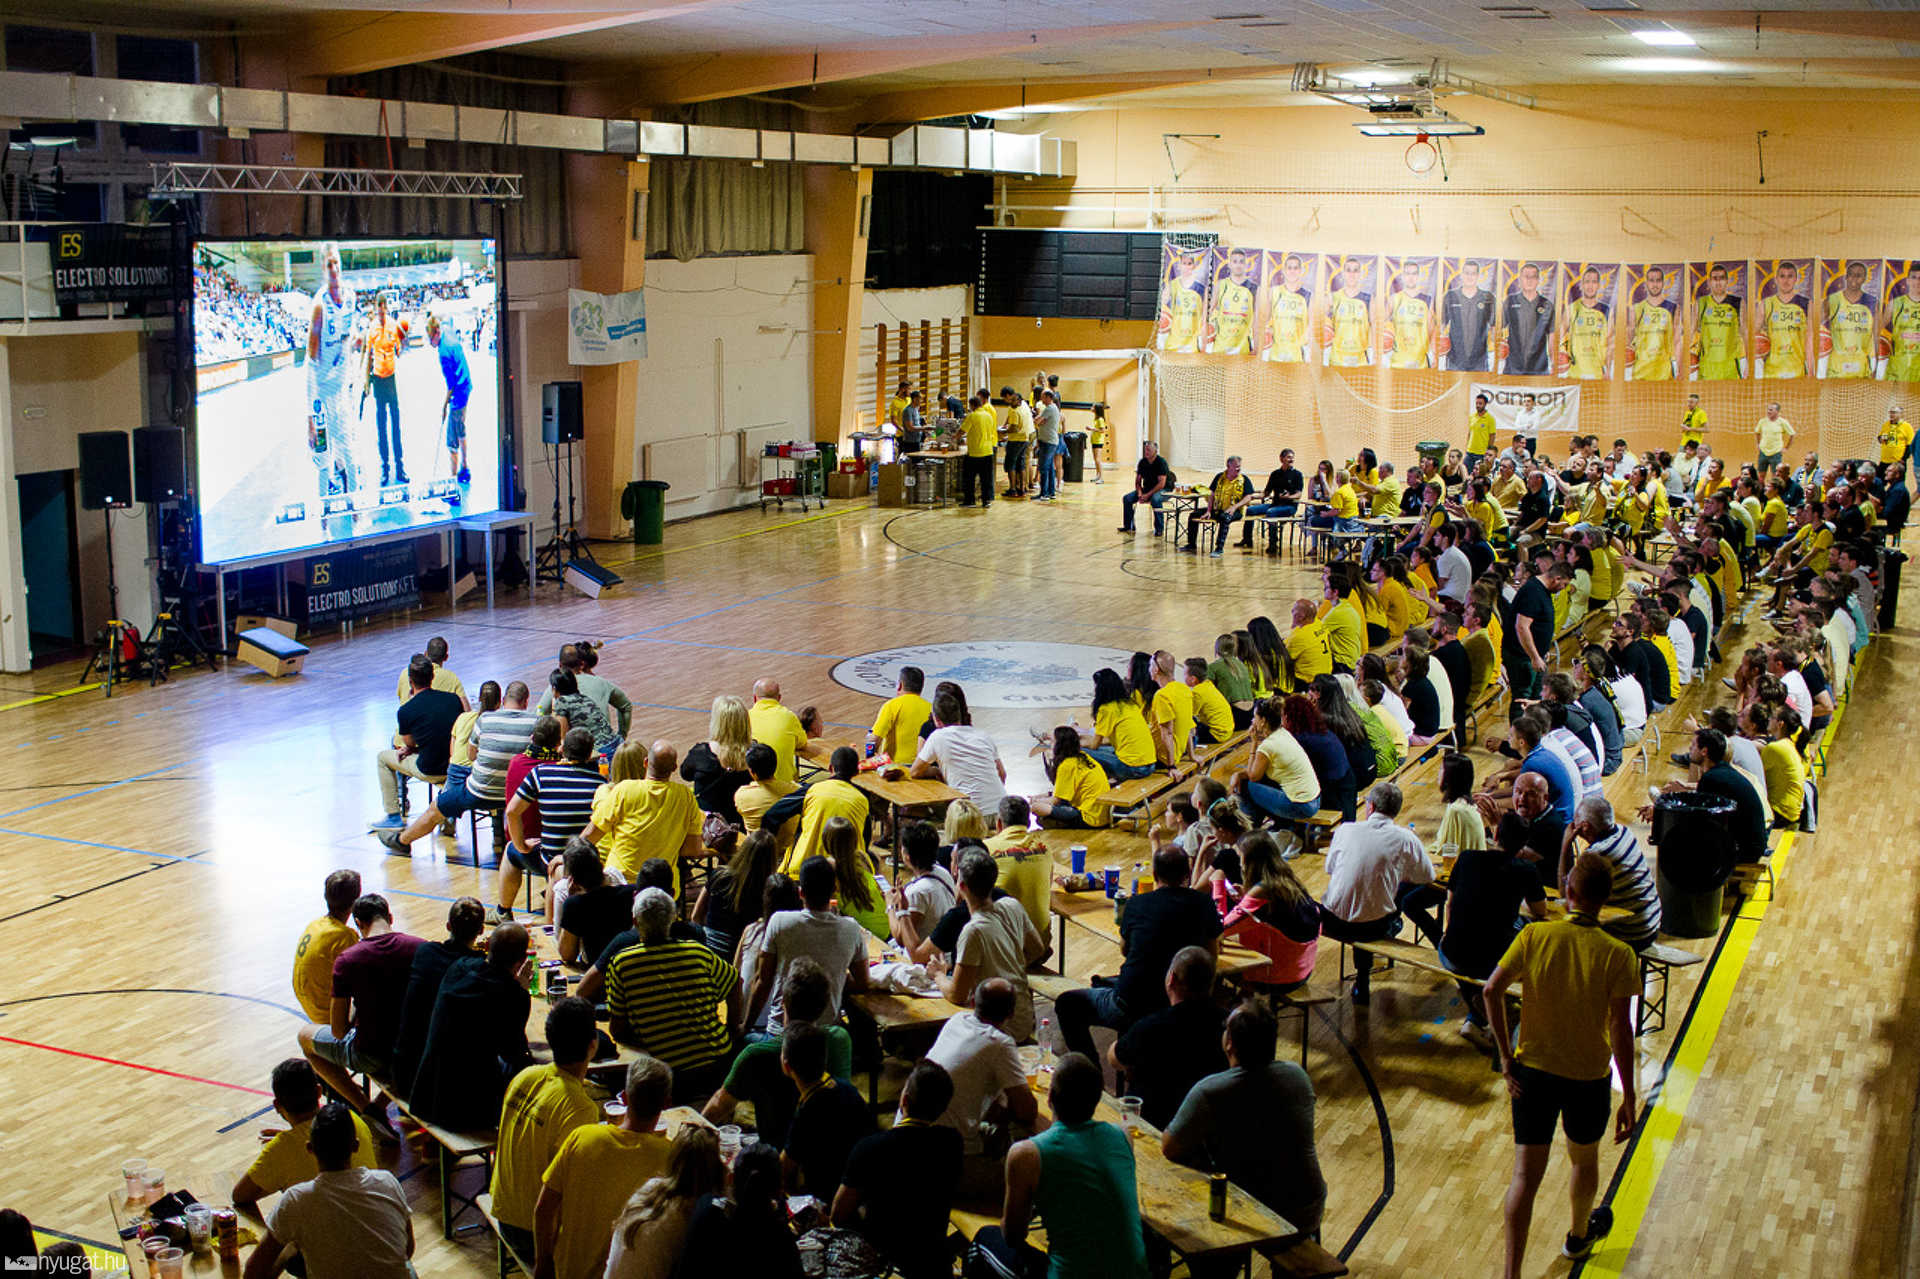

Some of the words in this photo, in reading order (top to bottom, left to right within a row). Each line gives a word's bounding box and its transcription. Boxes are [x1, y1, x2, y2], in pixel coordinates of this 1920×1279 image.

[60, 233, 82, 258] ES
[56, 267, 106, 289] ELECTRO
[108, 266, 168, 287] SOLUTIONS
[1780, 311, 1794, 322] 34
[312, 562, 331, 585] ES
[307, 589, 352, 614] ELECTRO
[351, 579, 398, 606] SOLUTIONS
[297, 934, 311, 957] 8
